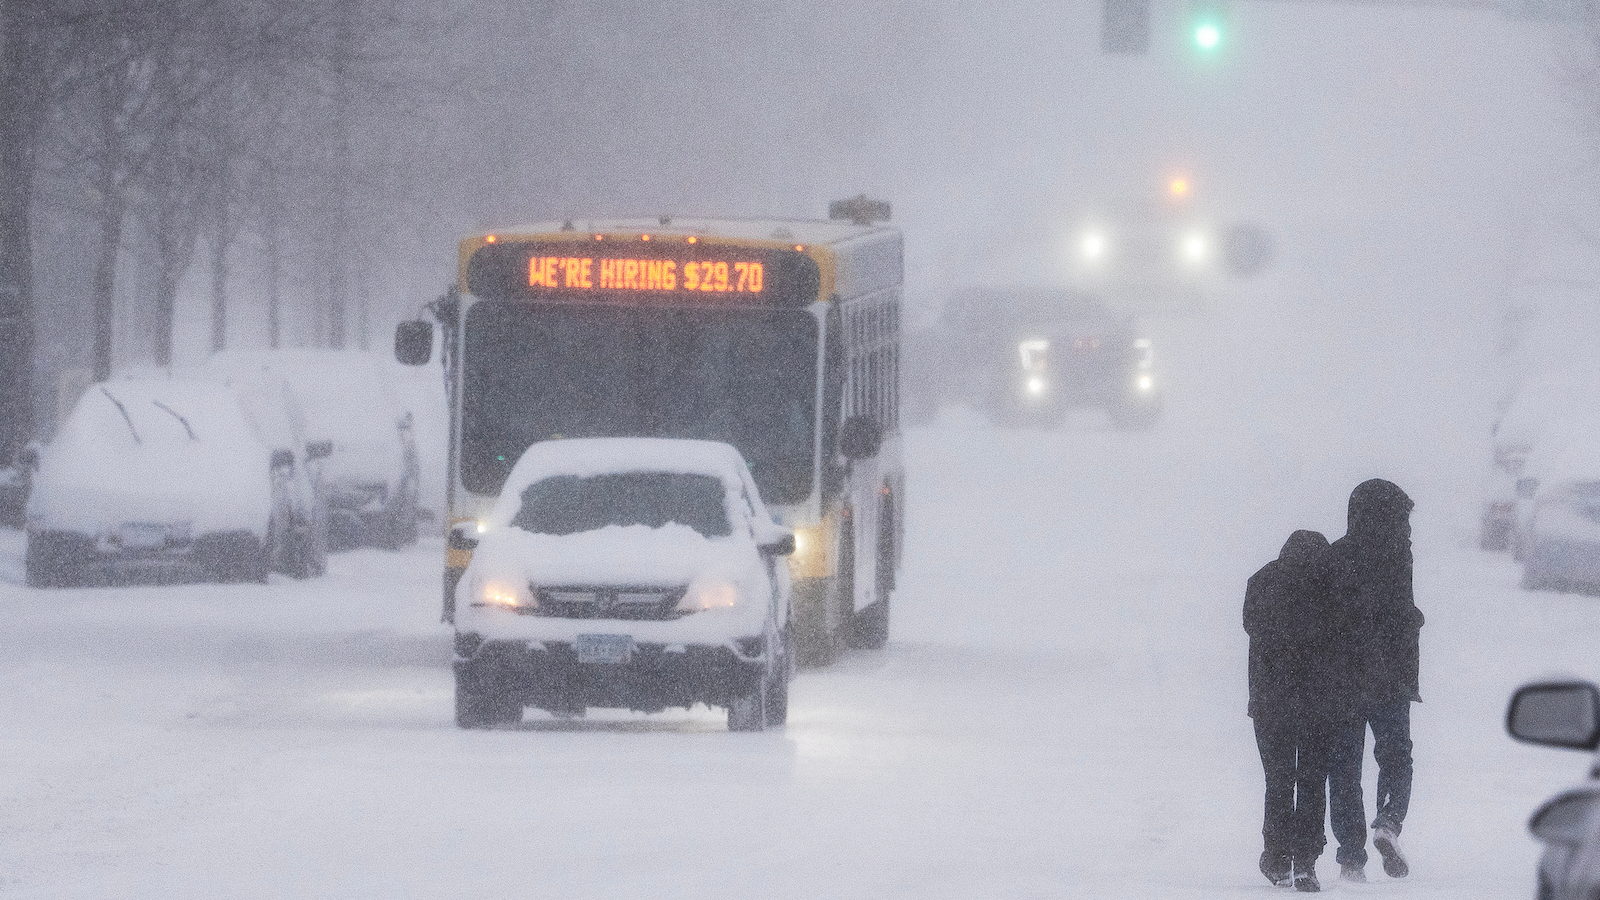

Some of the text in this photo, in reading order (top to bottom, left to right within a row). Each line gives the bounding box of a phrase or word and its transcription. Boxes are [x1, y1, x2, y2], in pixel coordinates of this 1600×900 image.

[529, 257, 763, 292] WE'RE HIRING $29.70
